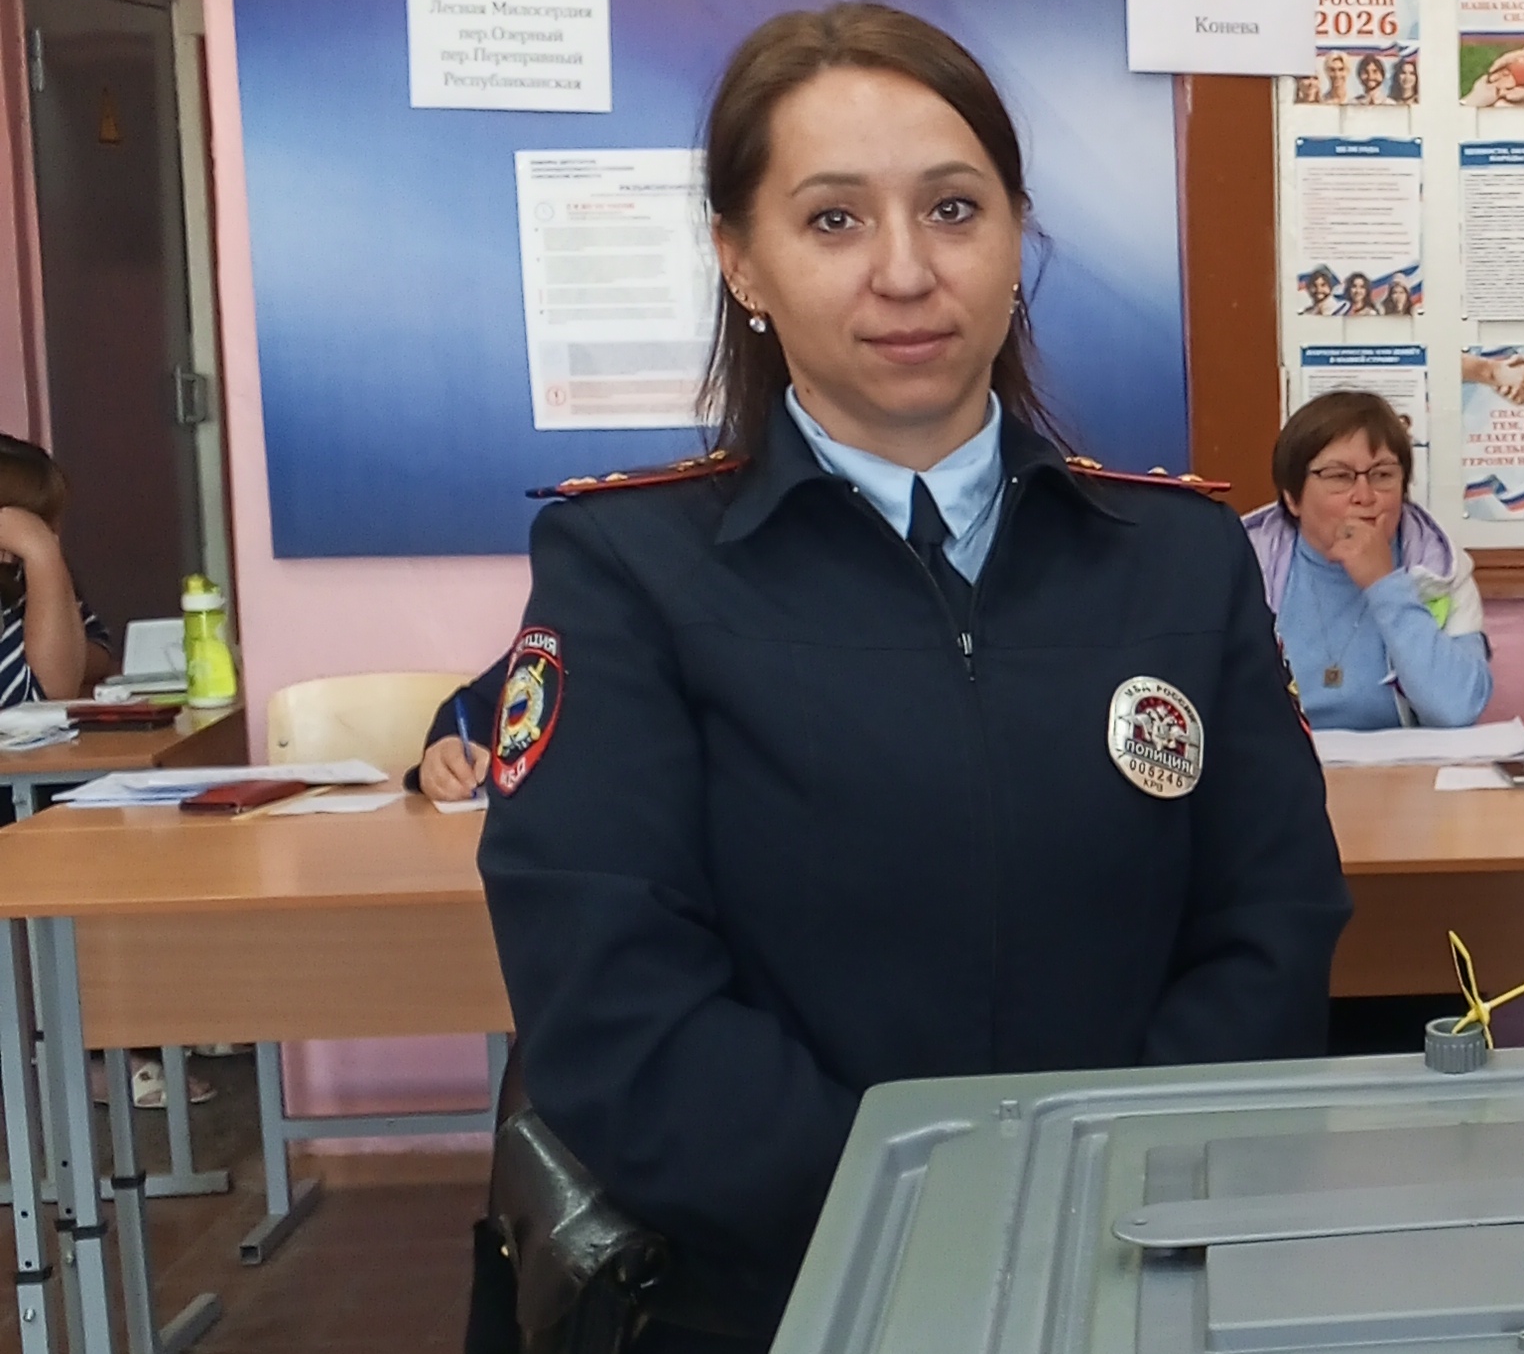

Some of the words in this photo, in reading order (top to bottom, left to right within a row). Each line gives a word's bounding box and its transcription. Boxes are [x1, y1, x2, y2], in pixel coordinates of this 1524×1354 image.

[1194, 16, 1260, 35] Конева
[1314, 10, 1398, 35] 2026
[1126, 740, 1190, 773] ПОЛИЦИЯ
